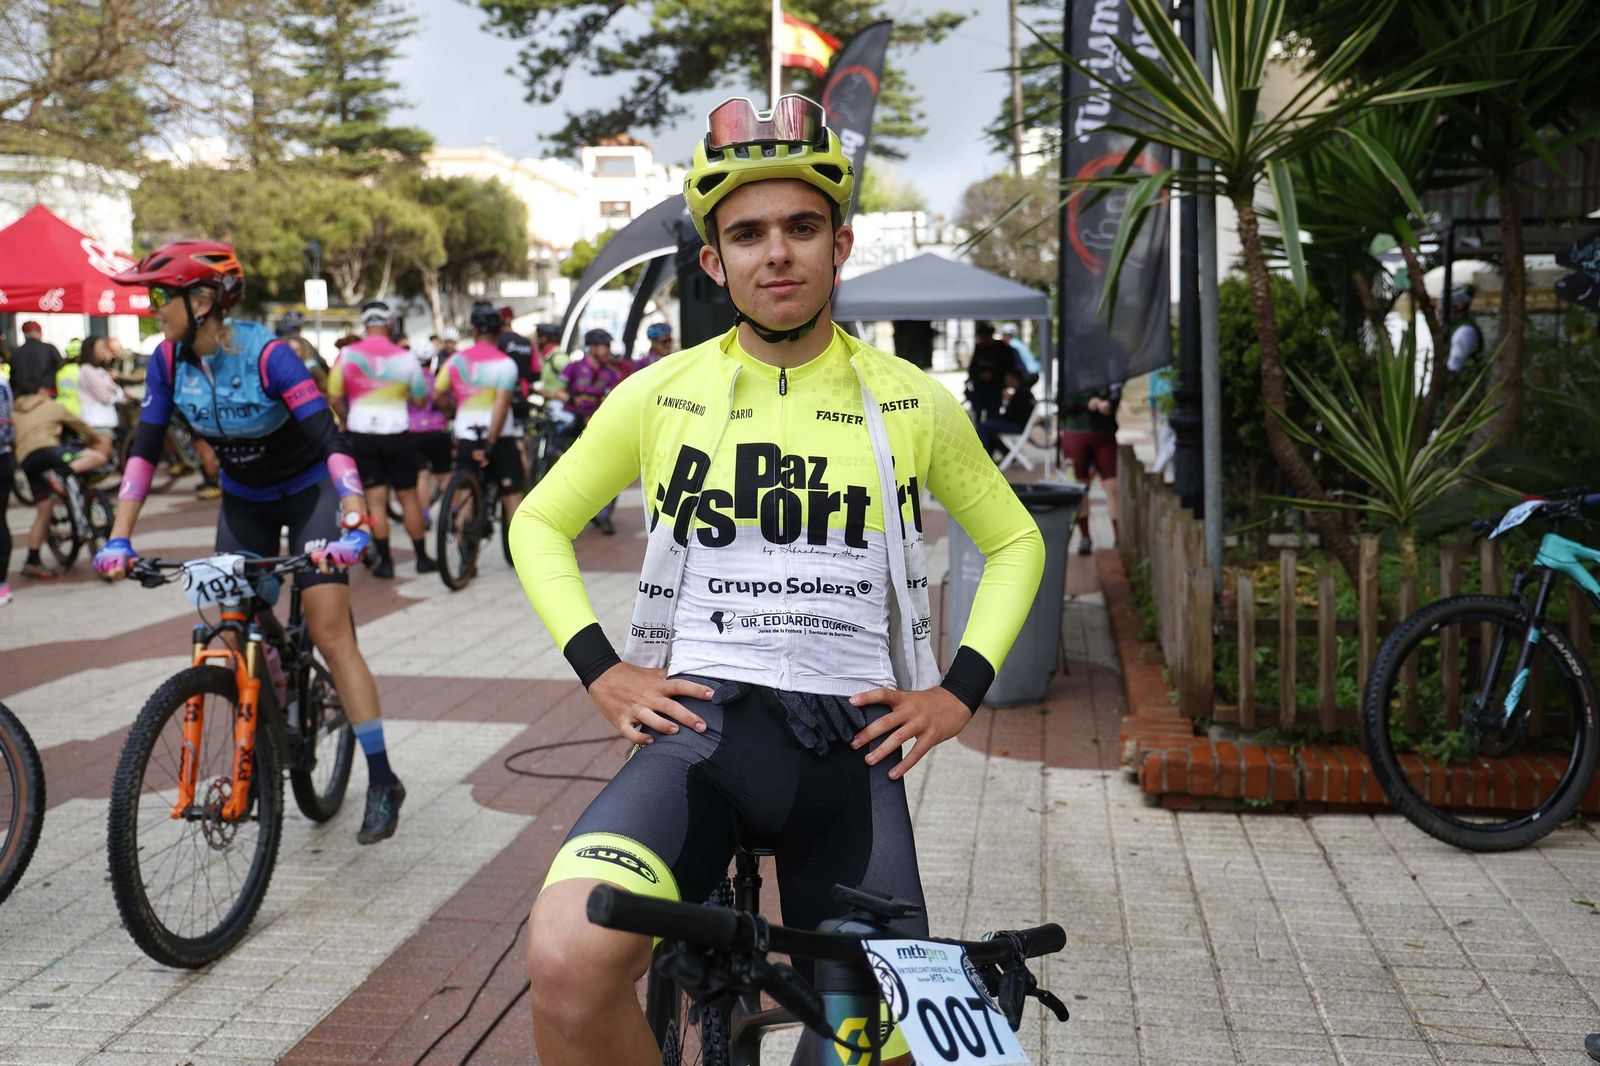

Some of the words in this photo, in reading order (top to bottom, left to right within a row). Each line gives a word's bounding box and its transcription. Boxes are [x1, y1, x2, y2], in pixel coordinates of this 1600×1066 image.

[657, 395, 662, 405] V
[663, 397, 706, 416] ANIVERSARIO
[816, 410, 863, 425] FASTER
[197, 575, 243, 602] 192
[741, 618, 760, 627] DR.
[764, 614, 819, 627] EDUARDO
[916, 996, 1005, 1062] 007
